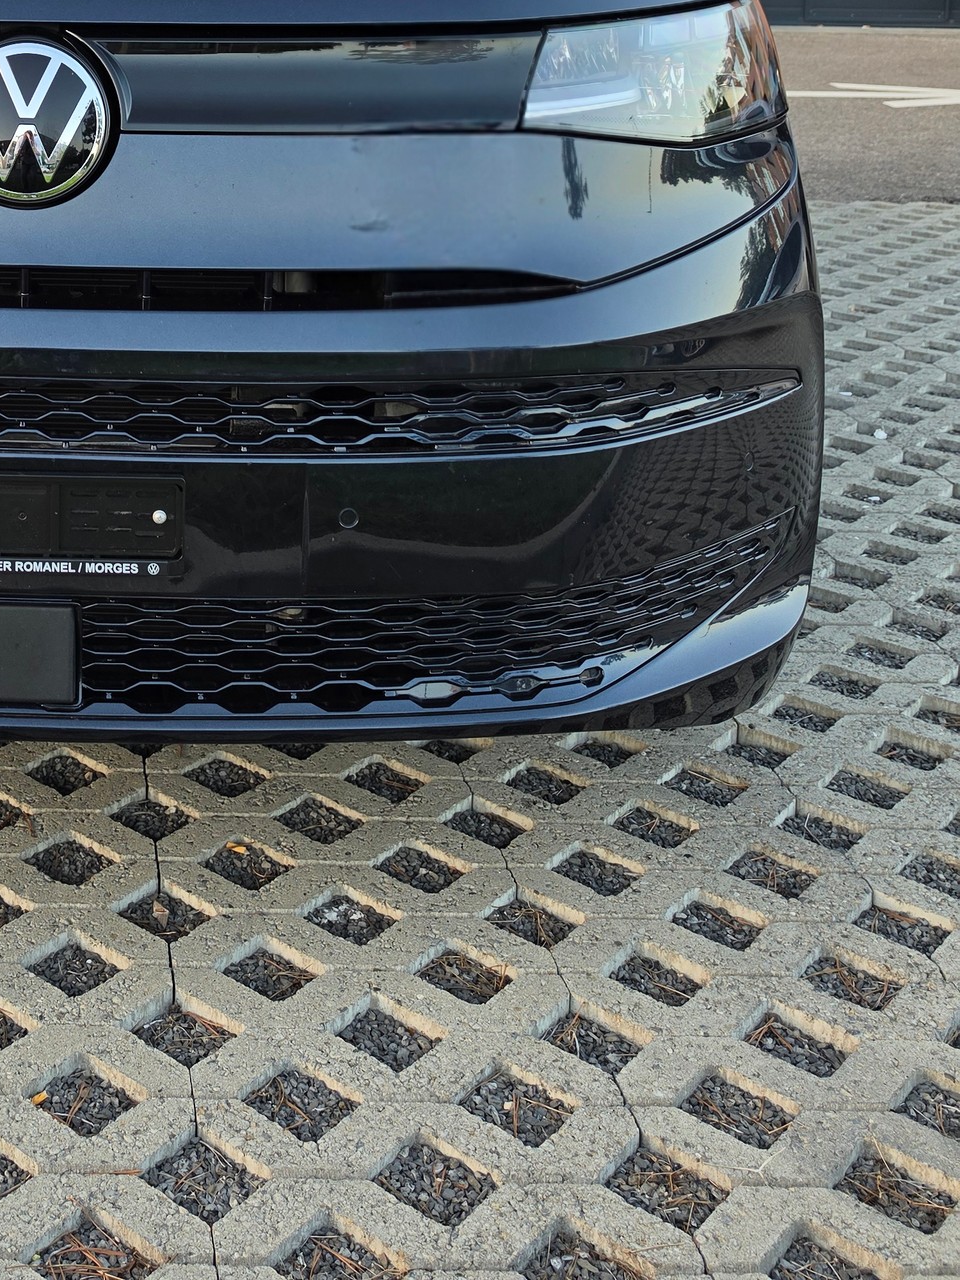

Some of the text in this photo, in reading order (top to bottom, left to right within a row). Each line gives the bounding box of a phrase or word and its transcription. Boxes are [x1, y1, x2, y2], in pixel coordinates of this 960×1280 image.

[14, 561, 76, 573] ROMANEL
[77, 562, 83, 573] /
[85, 562, 139, 574] MORGES
